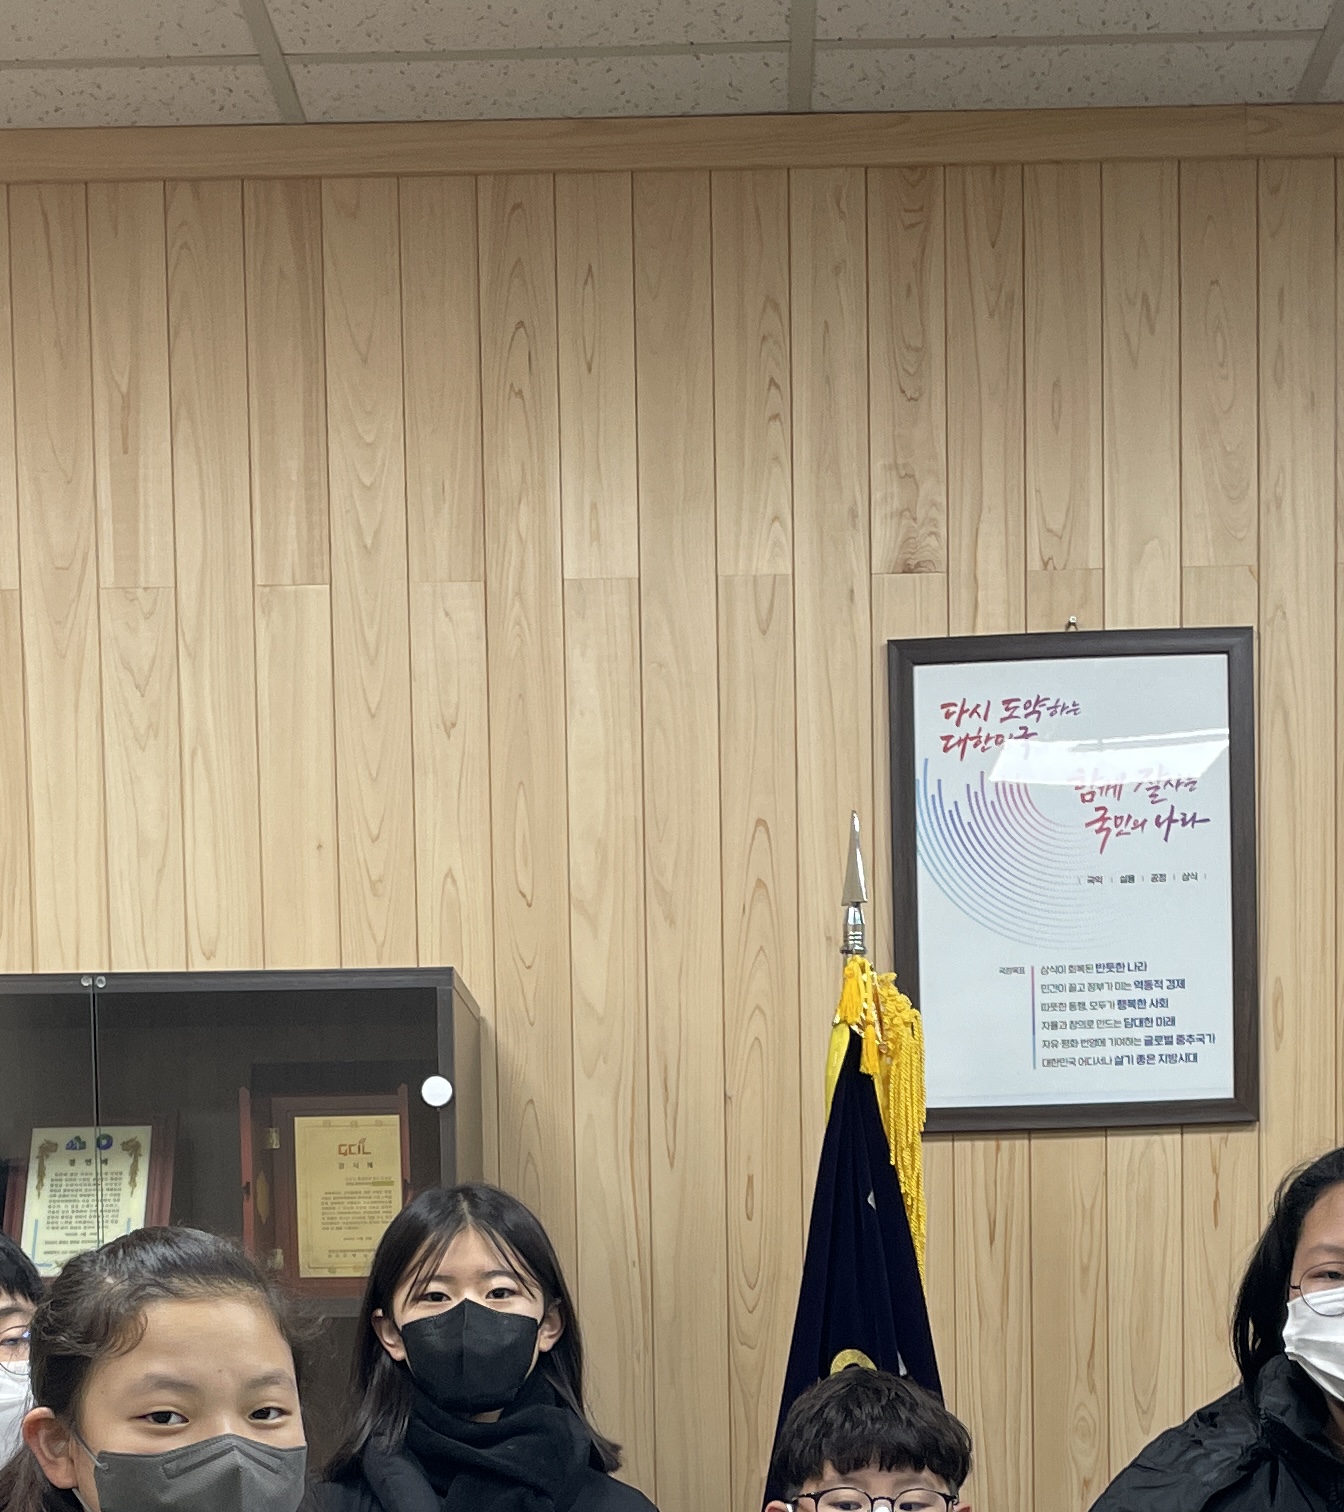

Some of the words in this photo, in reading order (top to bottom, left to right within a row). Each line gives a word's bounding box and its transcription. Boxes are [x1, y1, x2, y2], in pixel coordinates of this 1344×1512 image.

[940, 698, 991, 727] 다시
[999, 694, 1082, 723] 도약하는
[1085, 806, 1148, 855] 국민의
[1155, 804, 1211, 843] 나라
[1127, 961, 1147, 972] 나라
[1165, 978, 1186, 990] 경제
[1117, 998, 1146, 1010] 행복한
[1149, 998, 1169, 1008] 사회
[1155, 1016, 1176, 1027] 미래
[1144, 1035, 1173, 1046] 글로벌
[1176, 1033, 1216, 1045] 중추국가
[1158, 1052, 1198, 1064] 지방시대
